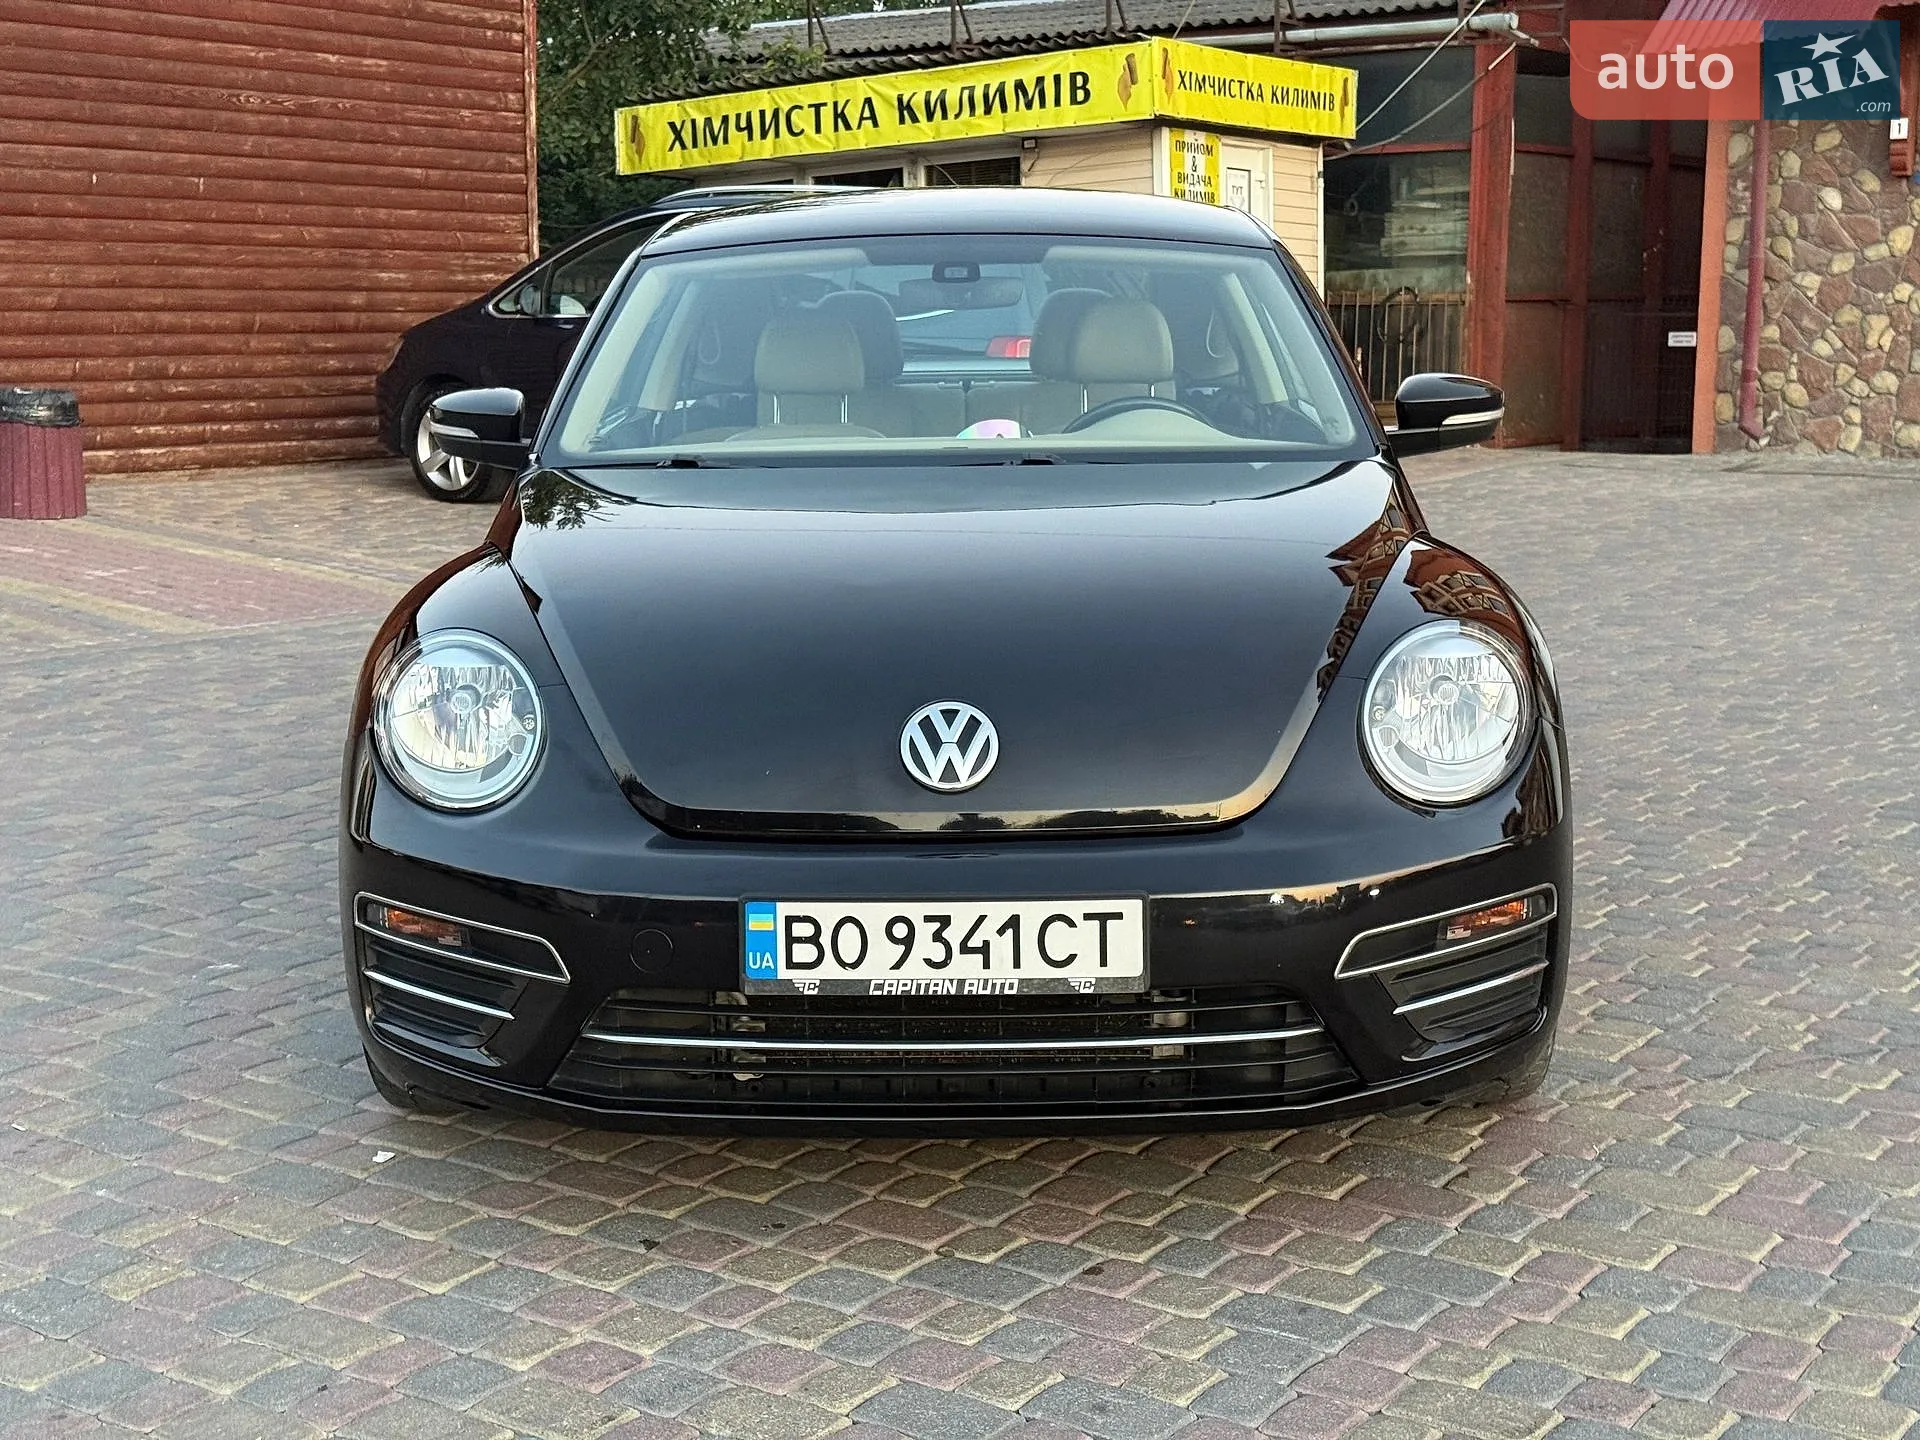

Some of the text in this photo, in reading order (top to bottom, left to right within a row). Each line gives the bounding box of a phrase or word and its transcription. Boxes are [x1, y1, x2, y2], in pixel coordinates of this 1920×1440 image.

[1177, 69, 1336, 112] ХІМЧИСТКА КИЛИМІВ
[667, 71, 1092, 152] ХІМЧИСТКА КИЛИМІВ
[1175, 138, 1214, 157] ПРИЙОМ
[1177, 171, 1212, 188] ВИДАЧА
[885, 914, 1021, 970] 9341
[748, 951, 775, 970] UA
[868, 978, 1019, 996] CAPITAN AUTO
